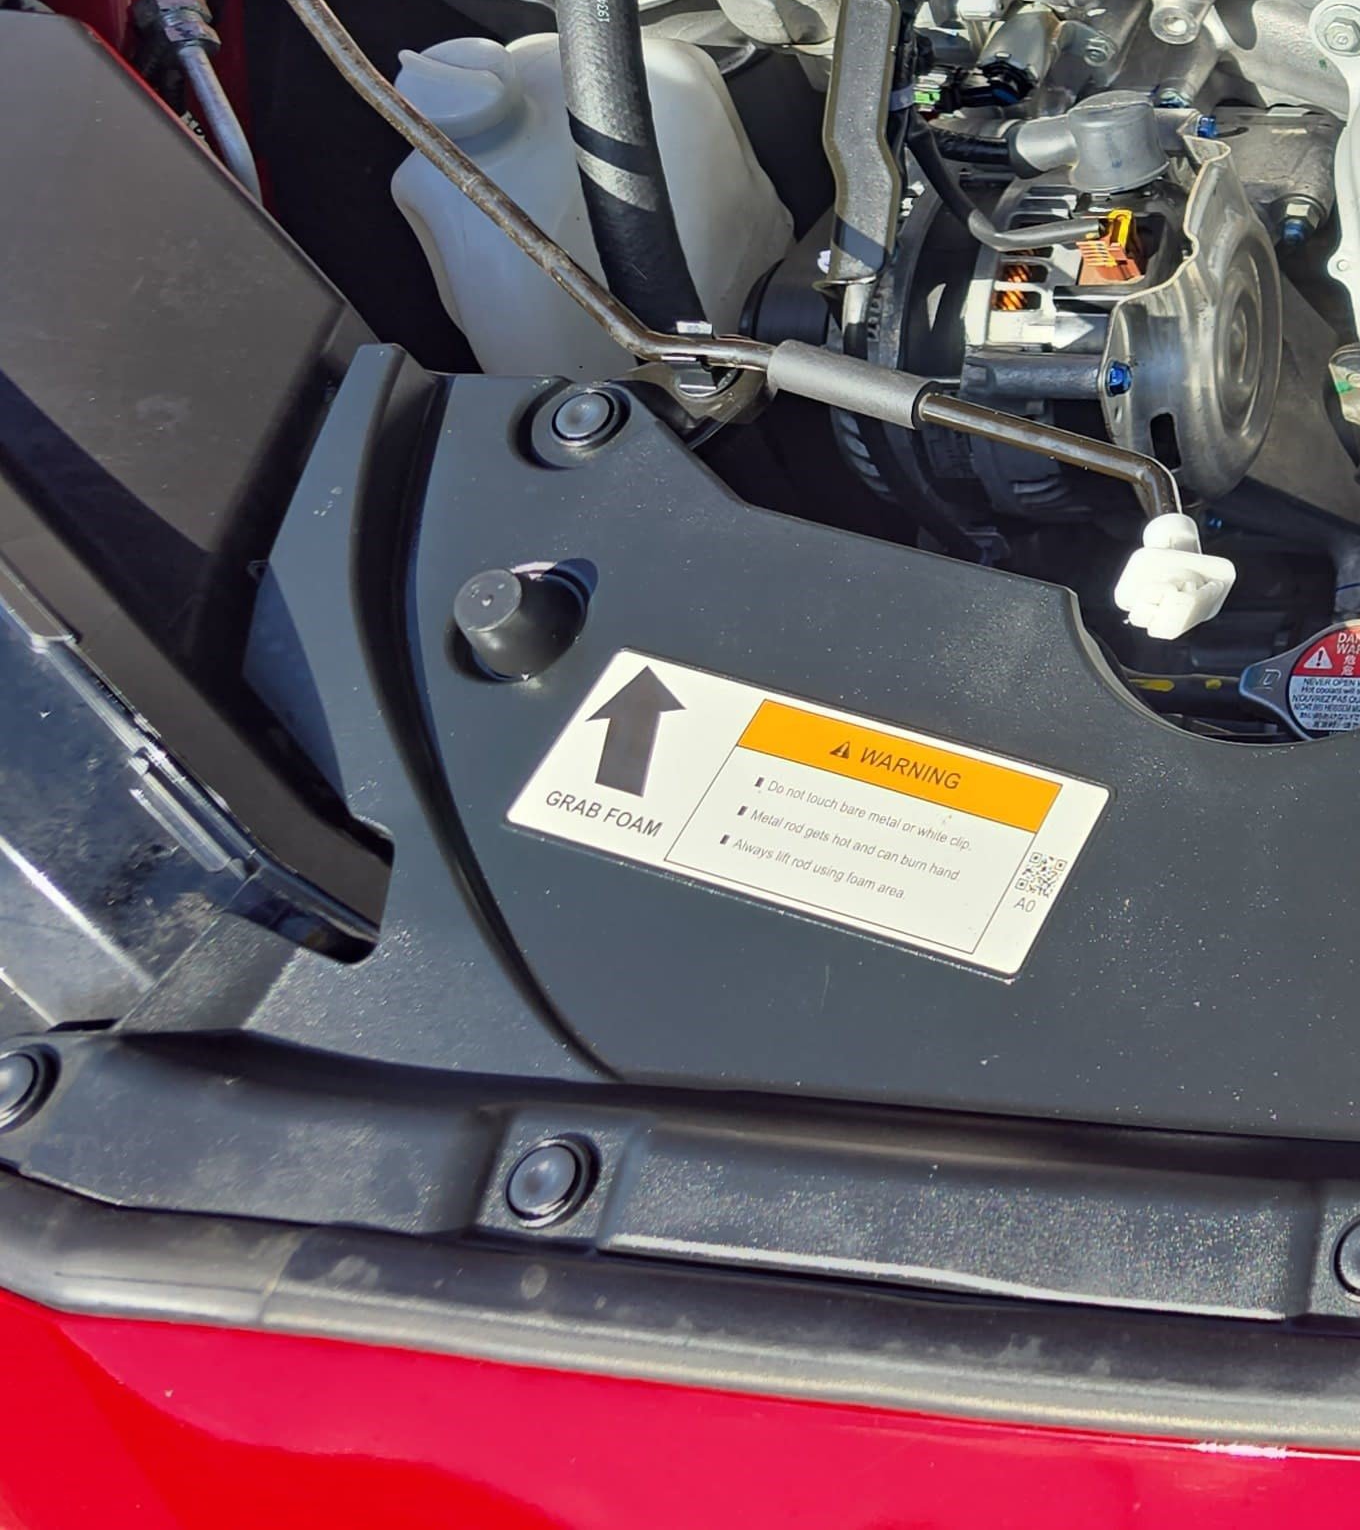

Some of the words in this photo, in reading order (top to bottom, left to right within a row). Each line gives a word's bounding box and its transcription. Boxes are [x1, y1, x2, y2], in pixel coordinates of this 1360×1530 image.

[1303, 678, 1330, 687] NEVER
[1332, 678, 1355, 687] OPEN
[860, 747, 962, 790] WARNING
[545, 789, 602, 820] GRAB
[603, 807, 664, 838] FOAM
[767, 779, 784, 794] Do
[786, 785, 806, 801] not
[806, 791, 838, 811] touch
[839, 800, 866, 818] bare
[868, 809, 902, 829] metal
[902, 820, 916, 833] or
[917, 826, 948, 844] white
[750, 809, 784, 828] Metal
[783, 819, 804, 834] rod
[804, 825, 829, 843] gets
[832, 832, 851, 848] hot
[852, 840, 876, 856] and
[876, 849, 899, 864] can
[901, 854, 928, 871] burn
[733, 838, 774, 860] Always
[776, 850, 791, 865] lift
[791, 857, 812, 872] rod
[812, 865, 845, 883] using
[846, 871, 876, 890] foam
[877, 884, 905, 900] area.
[1014, 897, 1037, 913] A0
